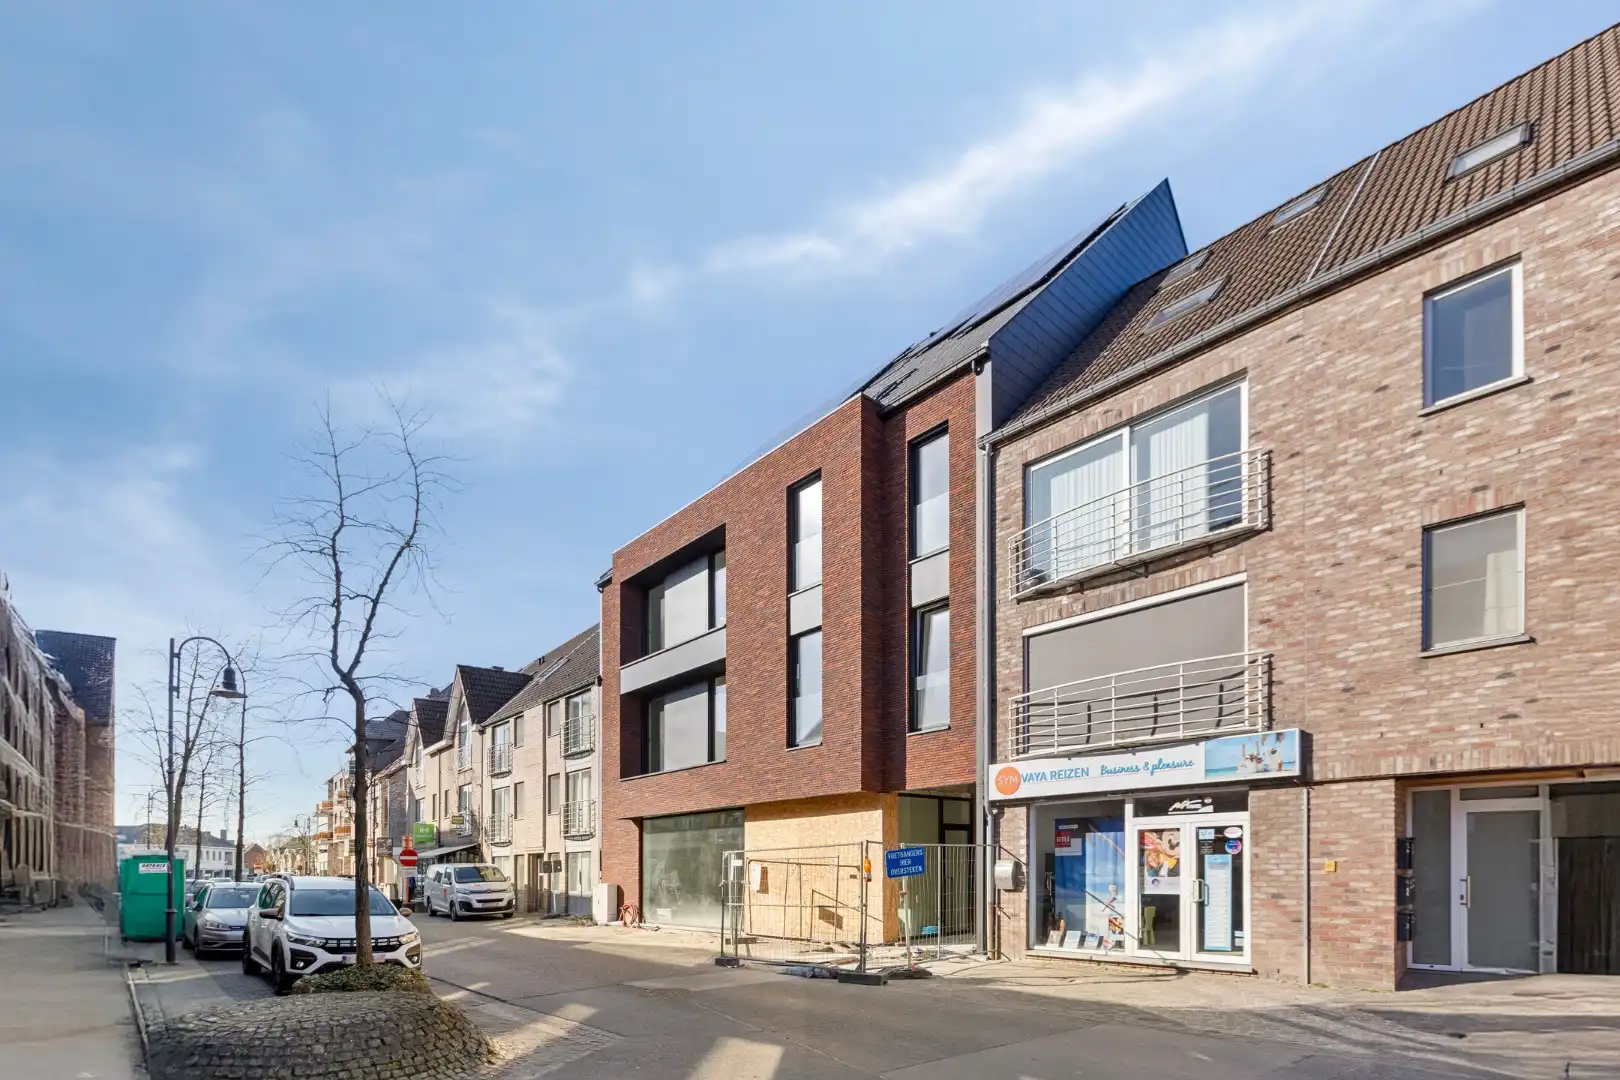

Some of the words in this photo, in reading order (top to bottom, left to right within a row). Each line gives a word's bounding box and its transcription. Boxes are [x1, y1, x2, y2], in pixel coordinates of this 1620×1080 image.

[1100, 764, 1141, 775] Business
[1142, 761, 1150, 771] &
[1150, 757, 1195, 776] pleasure
[1021, 771, 1047, 783] VAYA
[1050, 767, 1090, 781] REIZEN
[888, 849, 924, 859] VOETGANGERS
[890, 865, 922, 875] OVERSTEKEN
